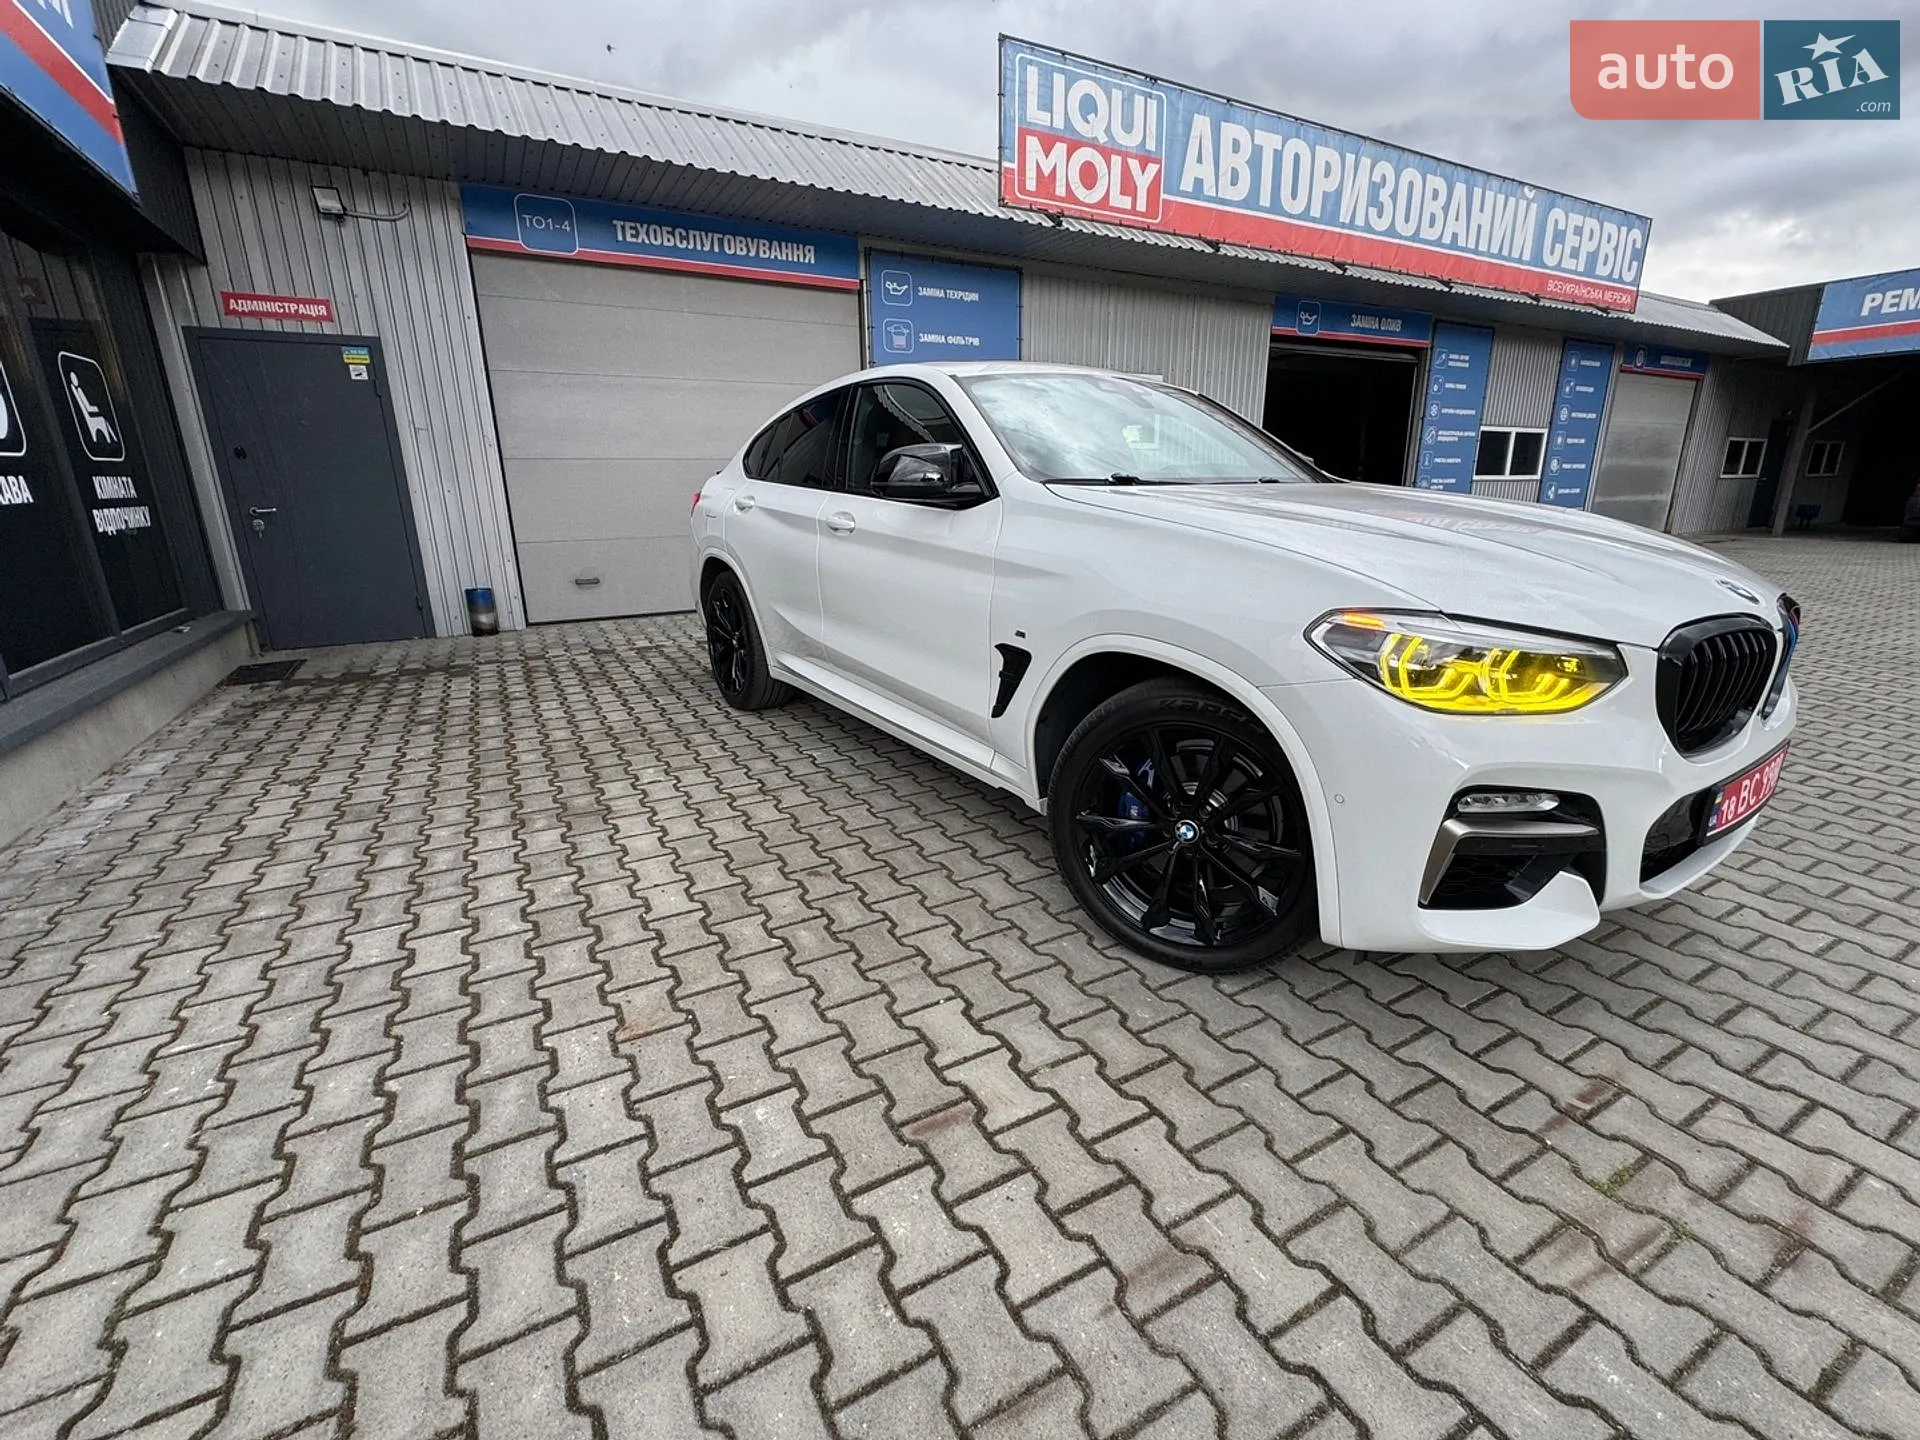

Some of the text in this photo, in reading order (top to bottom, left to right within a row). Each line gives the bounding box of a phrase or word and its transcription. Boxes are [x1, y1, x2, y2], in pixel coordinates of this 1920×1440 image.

[1027, 65, 1157, 152] LIQUI
[1025, 135, 1160, 212] MOLY
[1180, 113, 1643, 283] АВТОРИЗОВАНИЙ СЕРВІС
[613, 219, 816, 264] ТЕХОБСЛУГОВУВАННЯ
[918, 286, 945, 298] ЗАМІНА
[1547, 279, 1603, 300] ВСЕУКРАЇНСЬКА
[229, 299, 327, 317] АДМІНІСТРАЦІЯ
[919, 332, 946, 344] ЗАМІНА
[92, 475, 138, 499] КІМНАТА
[92, 505, 151, 536] ВІДПОЧИНКУ
